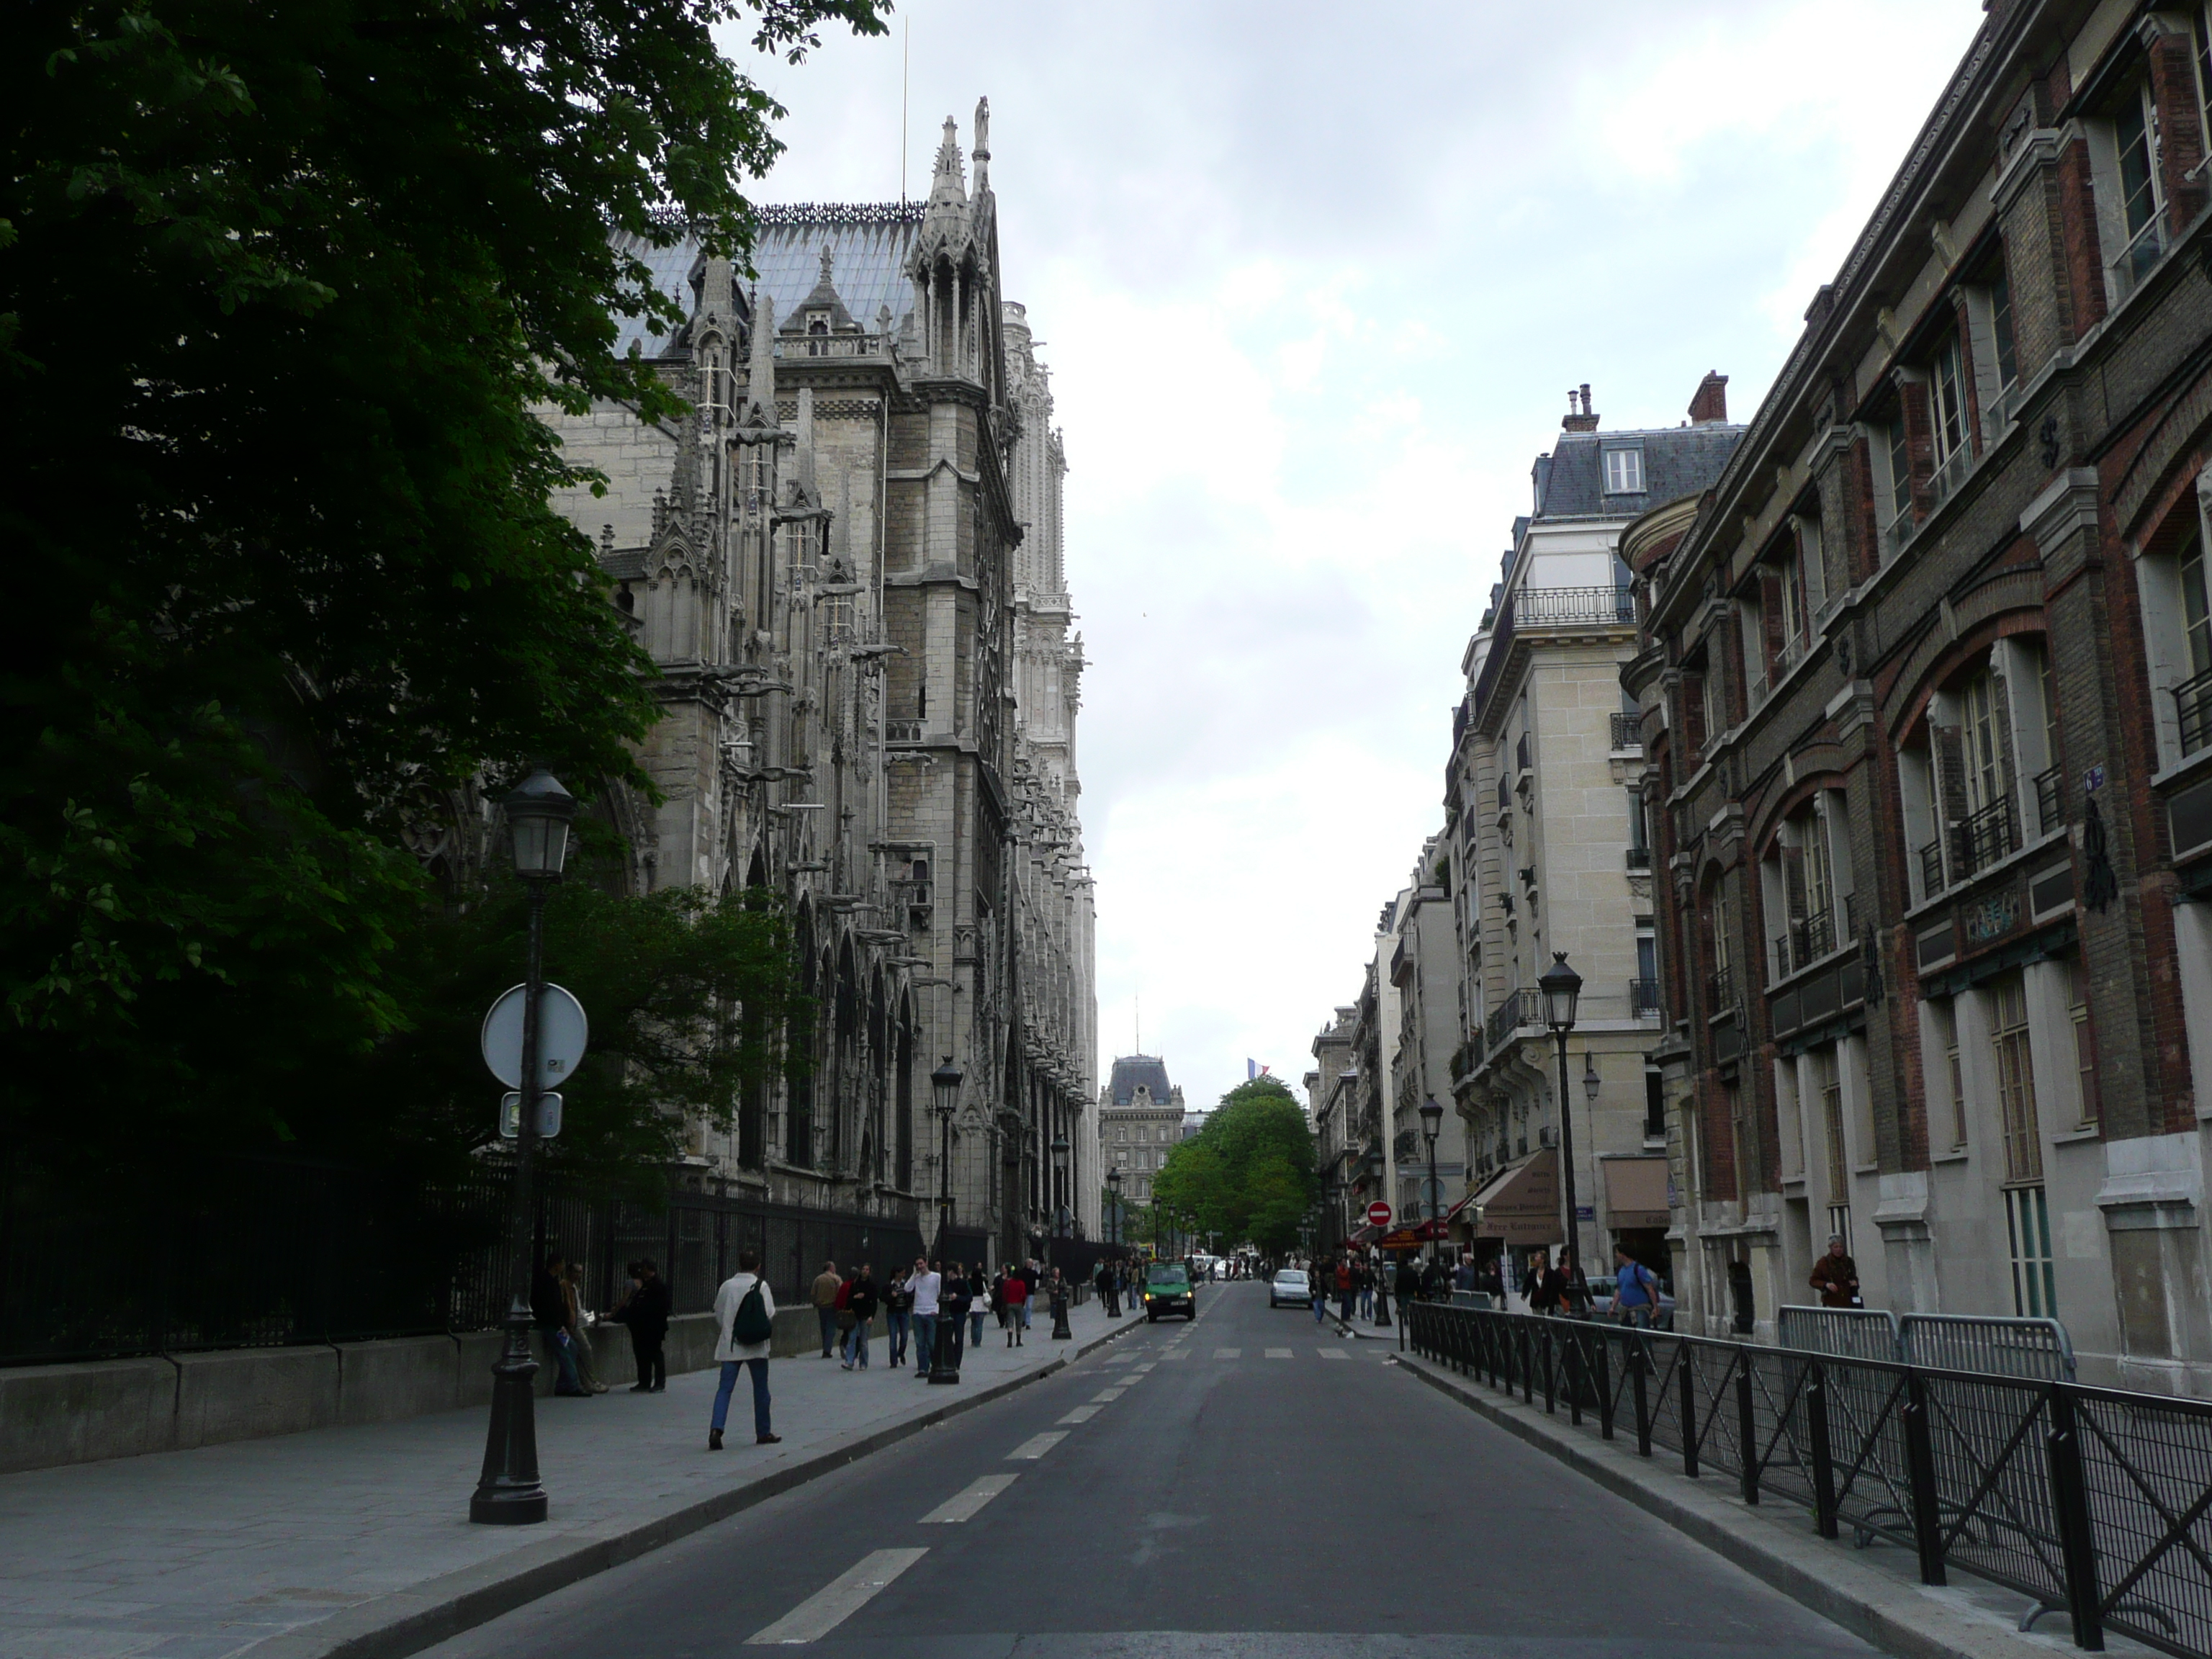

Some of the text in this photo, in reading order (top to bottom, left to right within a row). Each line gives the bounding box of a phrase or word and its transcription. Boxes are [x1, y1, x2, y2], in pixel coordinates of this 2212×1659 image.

[2086, 773, 2092, 791] 6
[1486, 1222, 1552, 1231] Free Entrance
